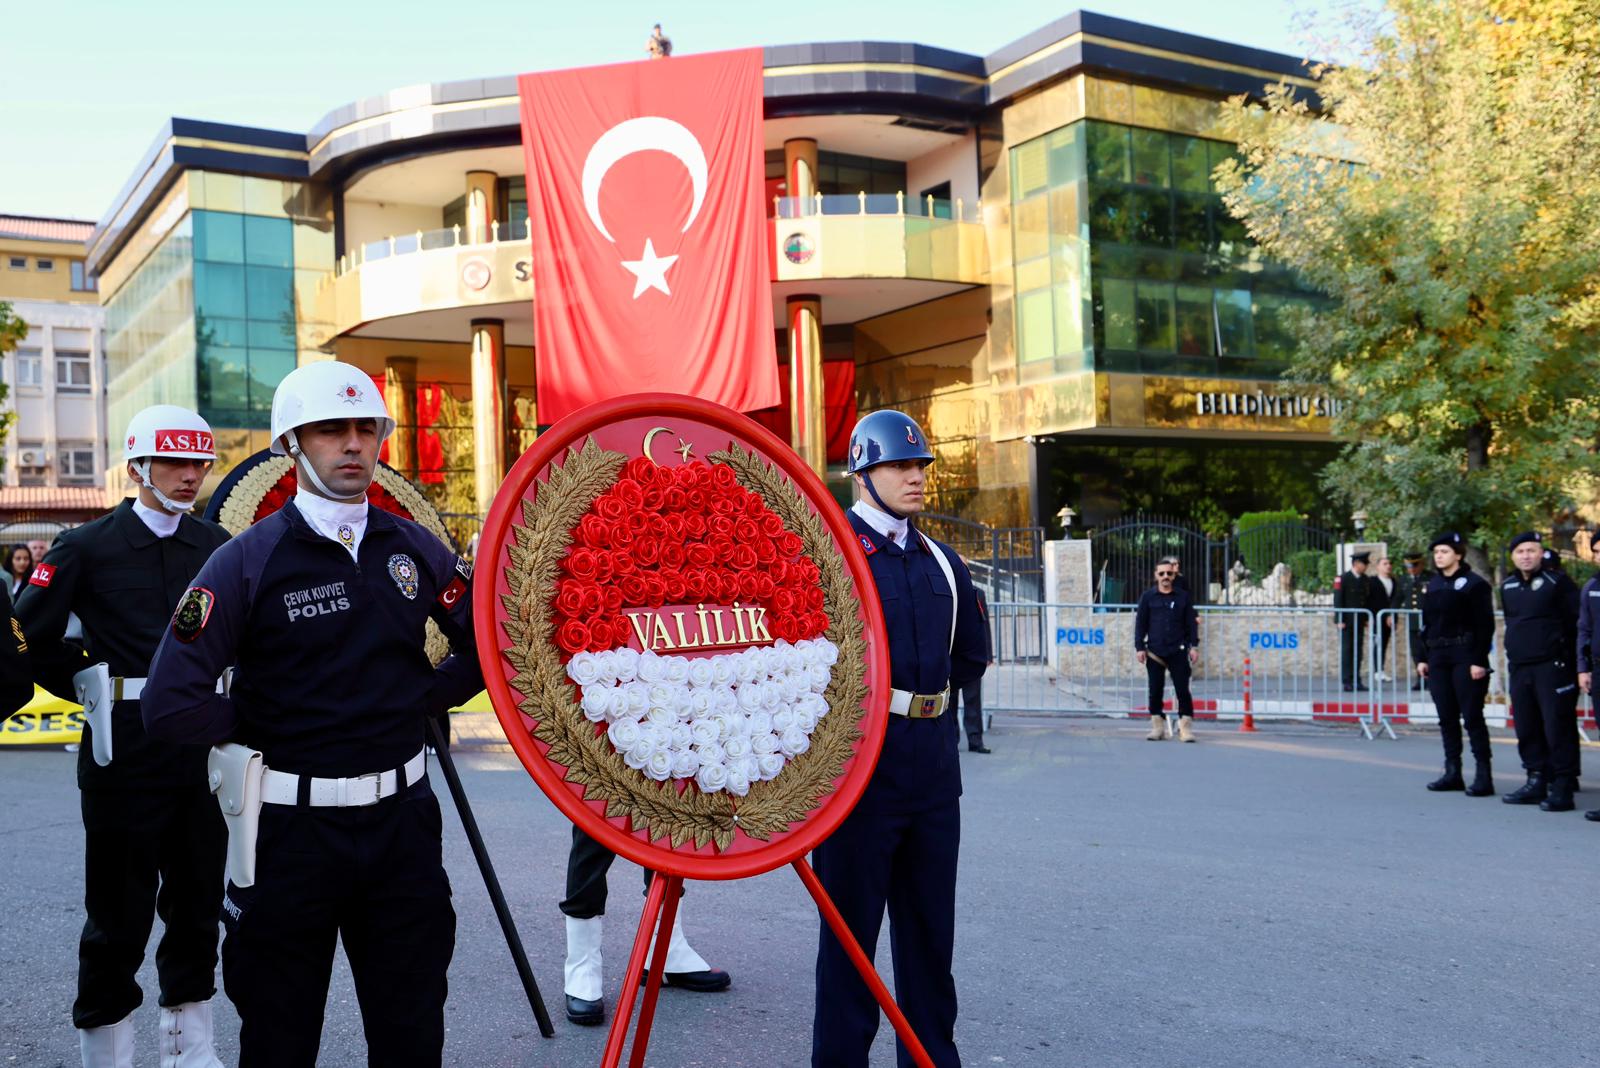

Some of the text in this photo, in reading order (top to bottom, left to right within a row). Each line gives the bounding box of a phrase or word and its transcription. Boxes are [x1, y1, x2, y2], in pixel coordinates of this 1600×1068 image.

[283, 581, 346, 610] ÇEVİK KUVVET
[626, 601, 774, 651] VALİLİK
